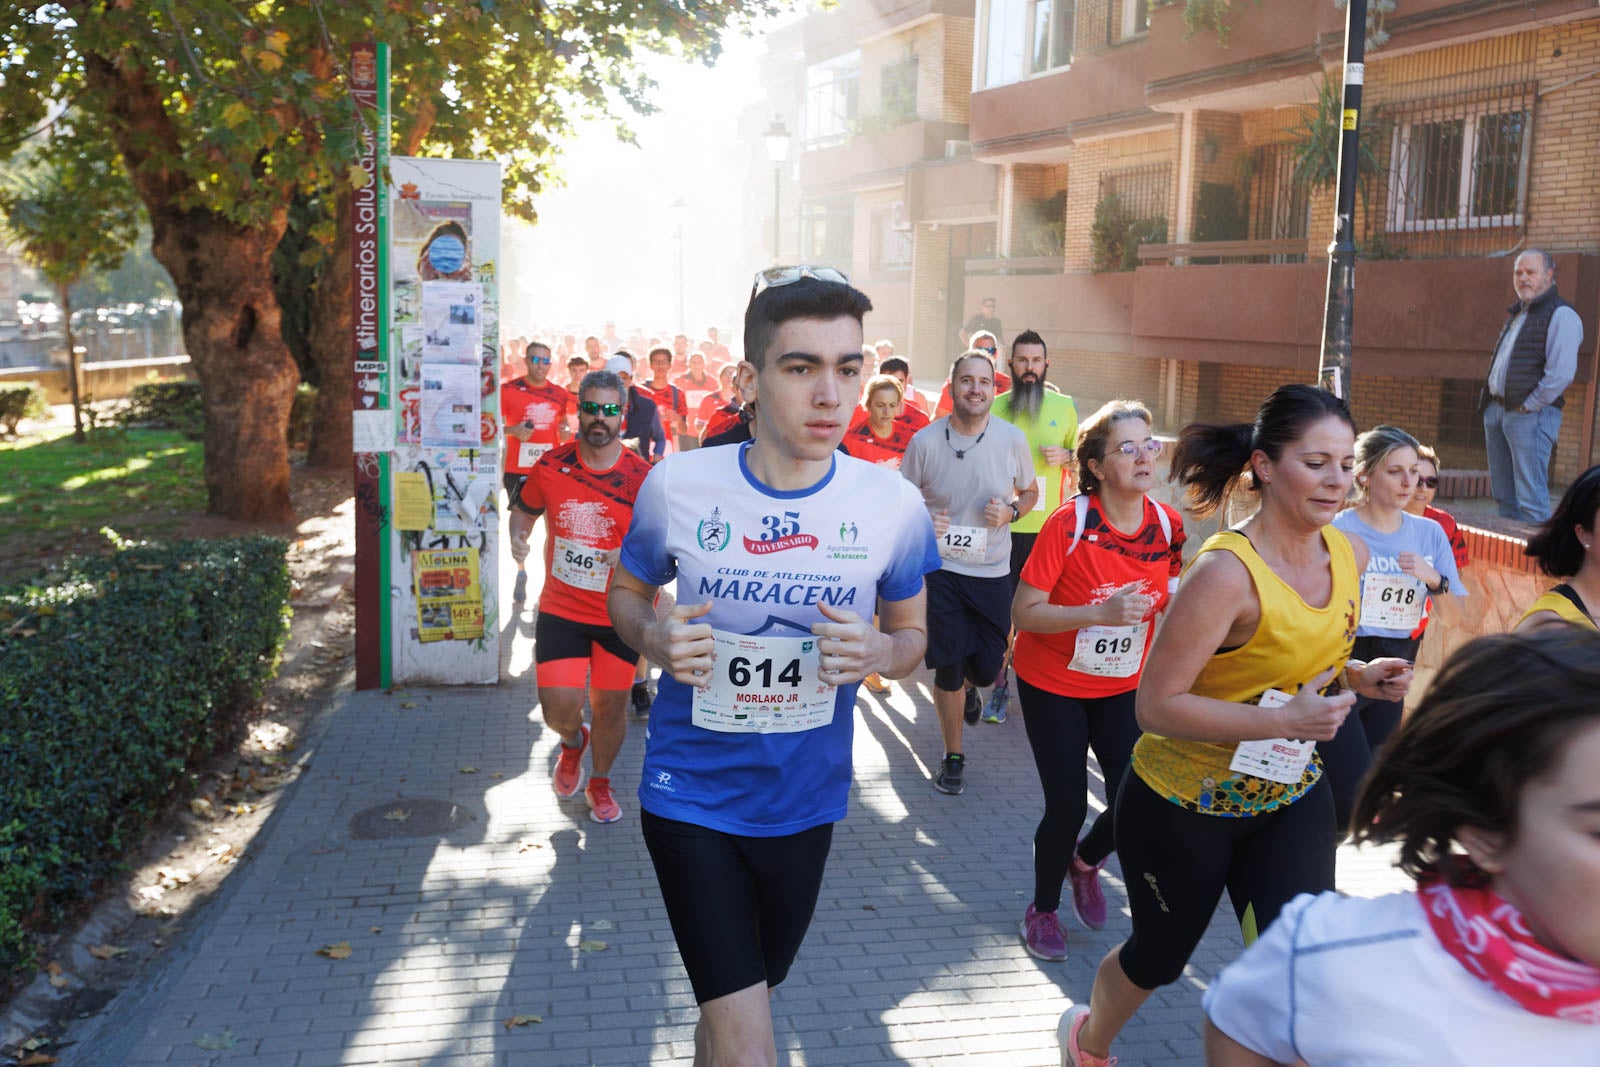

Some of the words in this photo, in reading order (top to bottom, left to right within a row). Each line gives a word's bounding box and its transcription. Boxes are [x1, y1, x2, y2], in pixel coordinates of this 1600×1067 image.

[559, 509, 609, 528] carrera
[760, 511, 801, 543] 35
[750, 535, 813, 554] ANIVERSARIO
[826, 545, 868, 553] Ayuntamiento
[944, 533, 972, 547] 122
[565, 550, 594, 569] 546
[833, 552, 868, 560] Maracena
[453, 568, 471, 589] B
[717, 567, 750, 577] CLUB
[753, 570, 769, 579] DE
[772, 571, 842, 583] ATLETISMO
[698, 576, 857, 606] MARACENA
[1381, 587, 1416, 605] 618
[452, 608, 471, 619] 149
[474, 607, 482, 616] €
[1094, 637, 1132, 654] 619
[728, 656, 802, 688] 614
[736, 692, 784, 703] MORLAKO
[786, 693, 799, 703] JR
